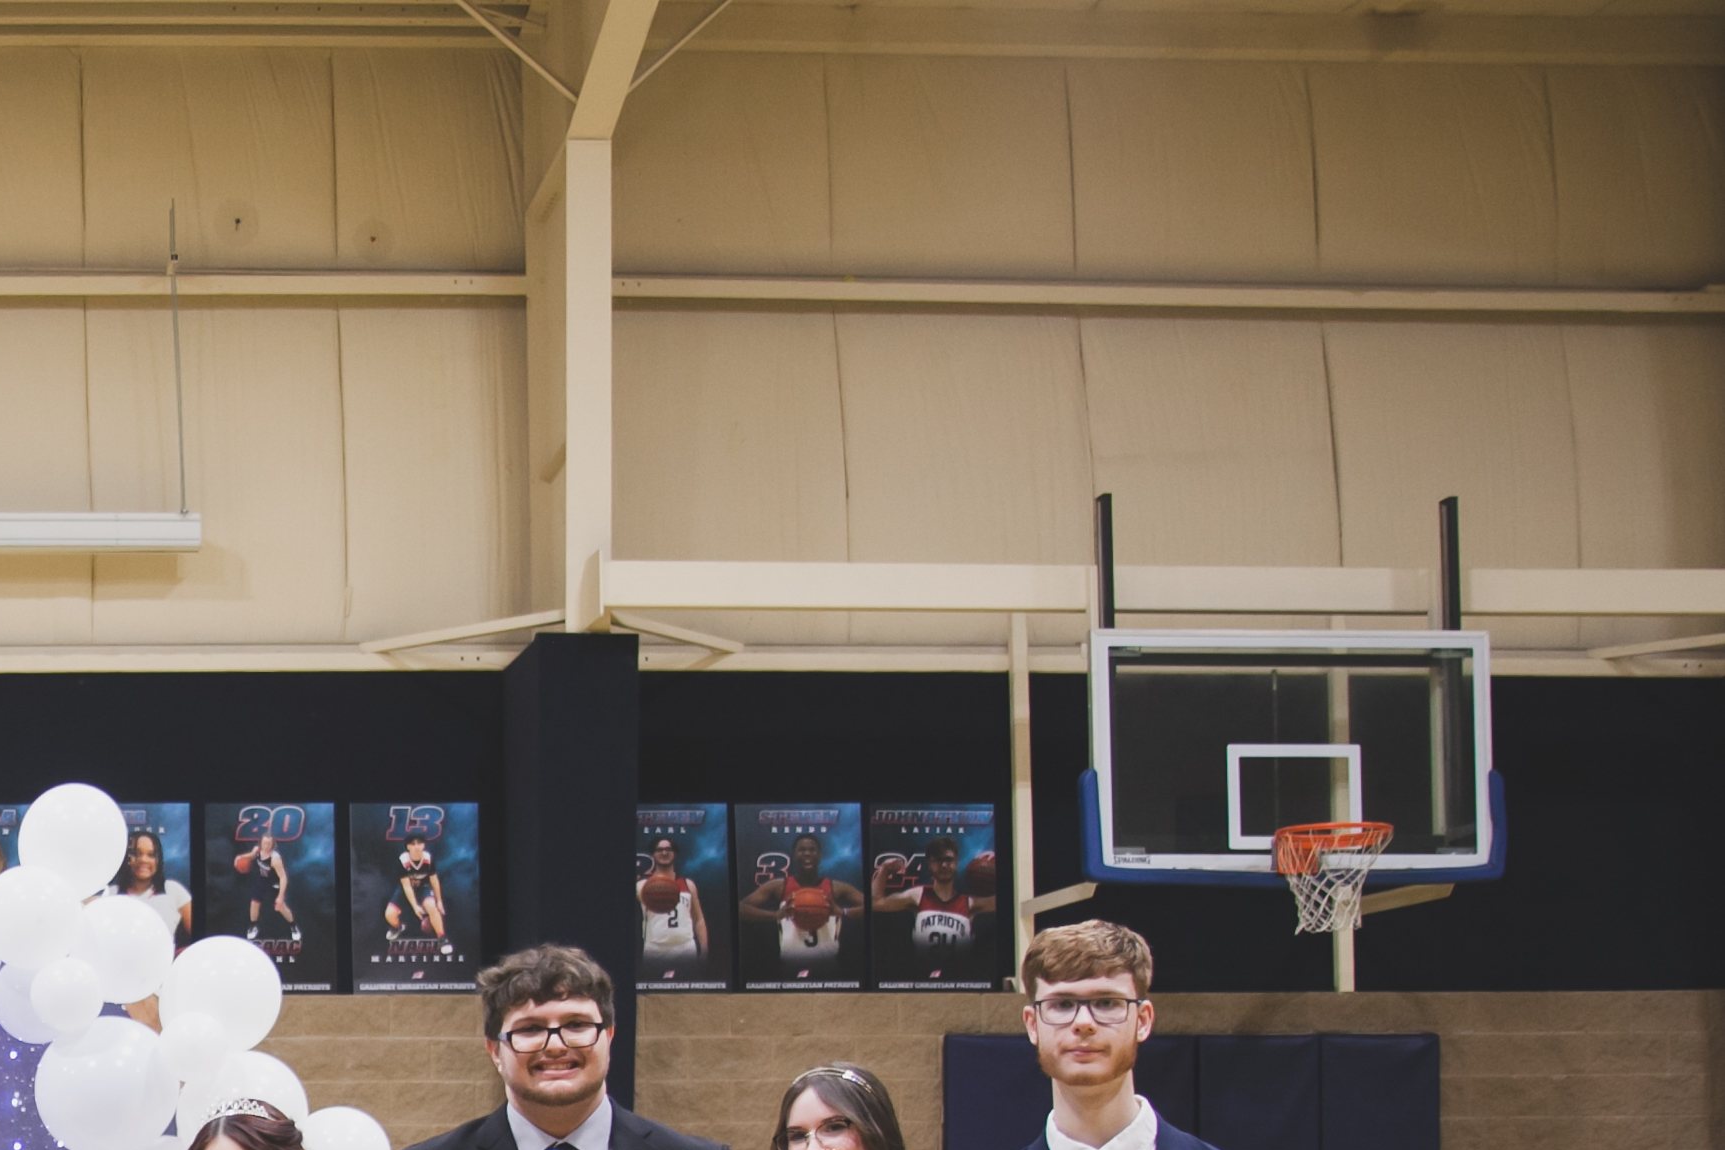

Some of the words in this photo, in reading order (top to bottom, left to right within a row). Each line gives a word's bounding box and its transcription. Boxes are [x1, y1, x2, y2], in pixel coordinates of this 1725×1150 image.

[235, 805, 303, 842] 20
[387, 805, 443, 842] 13
[636, 810, 705, 825] TEVEN
[758, 809, 838, 825] STEVEN
[754, 852, 791, 887] 3
[1113, 855, 1151, 865] SPALDING
[920, 914, 966, 938] PATRIOTS
